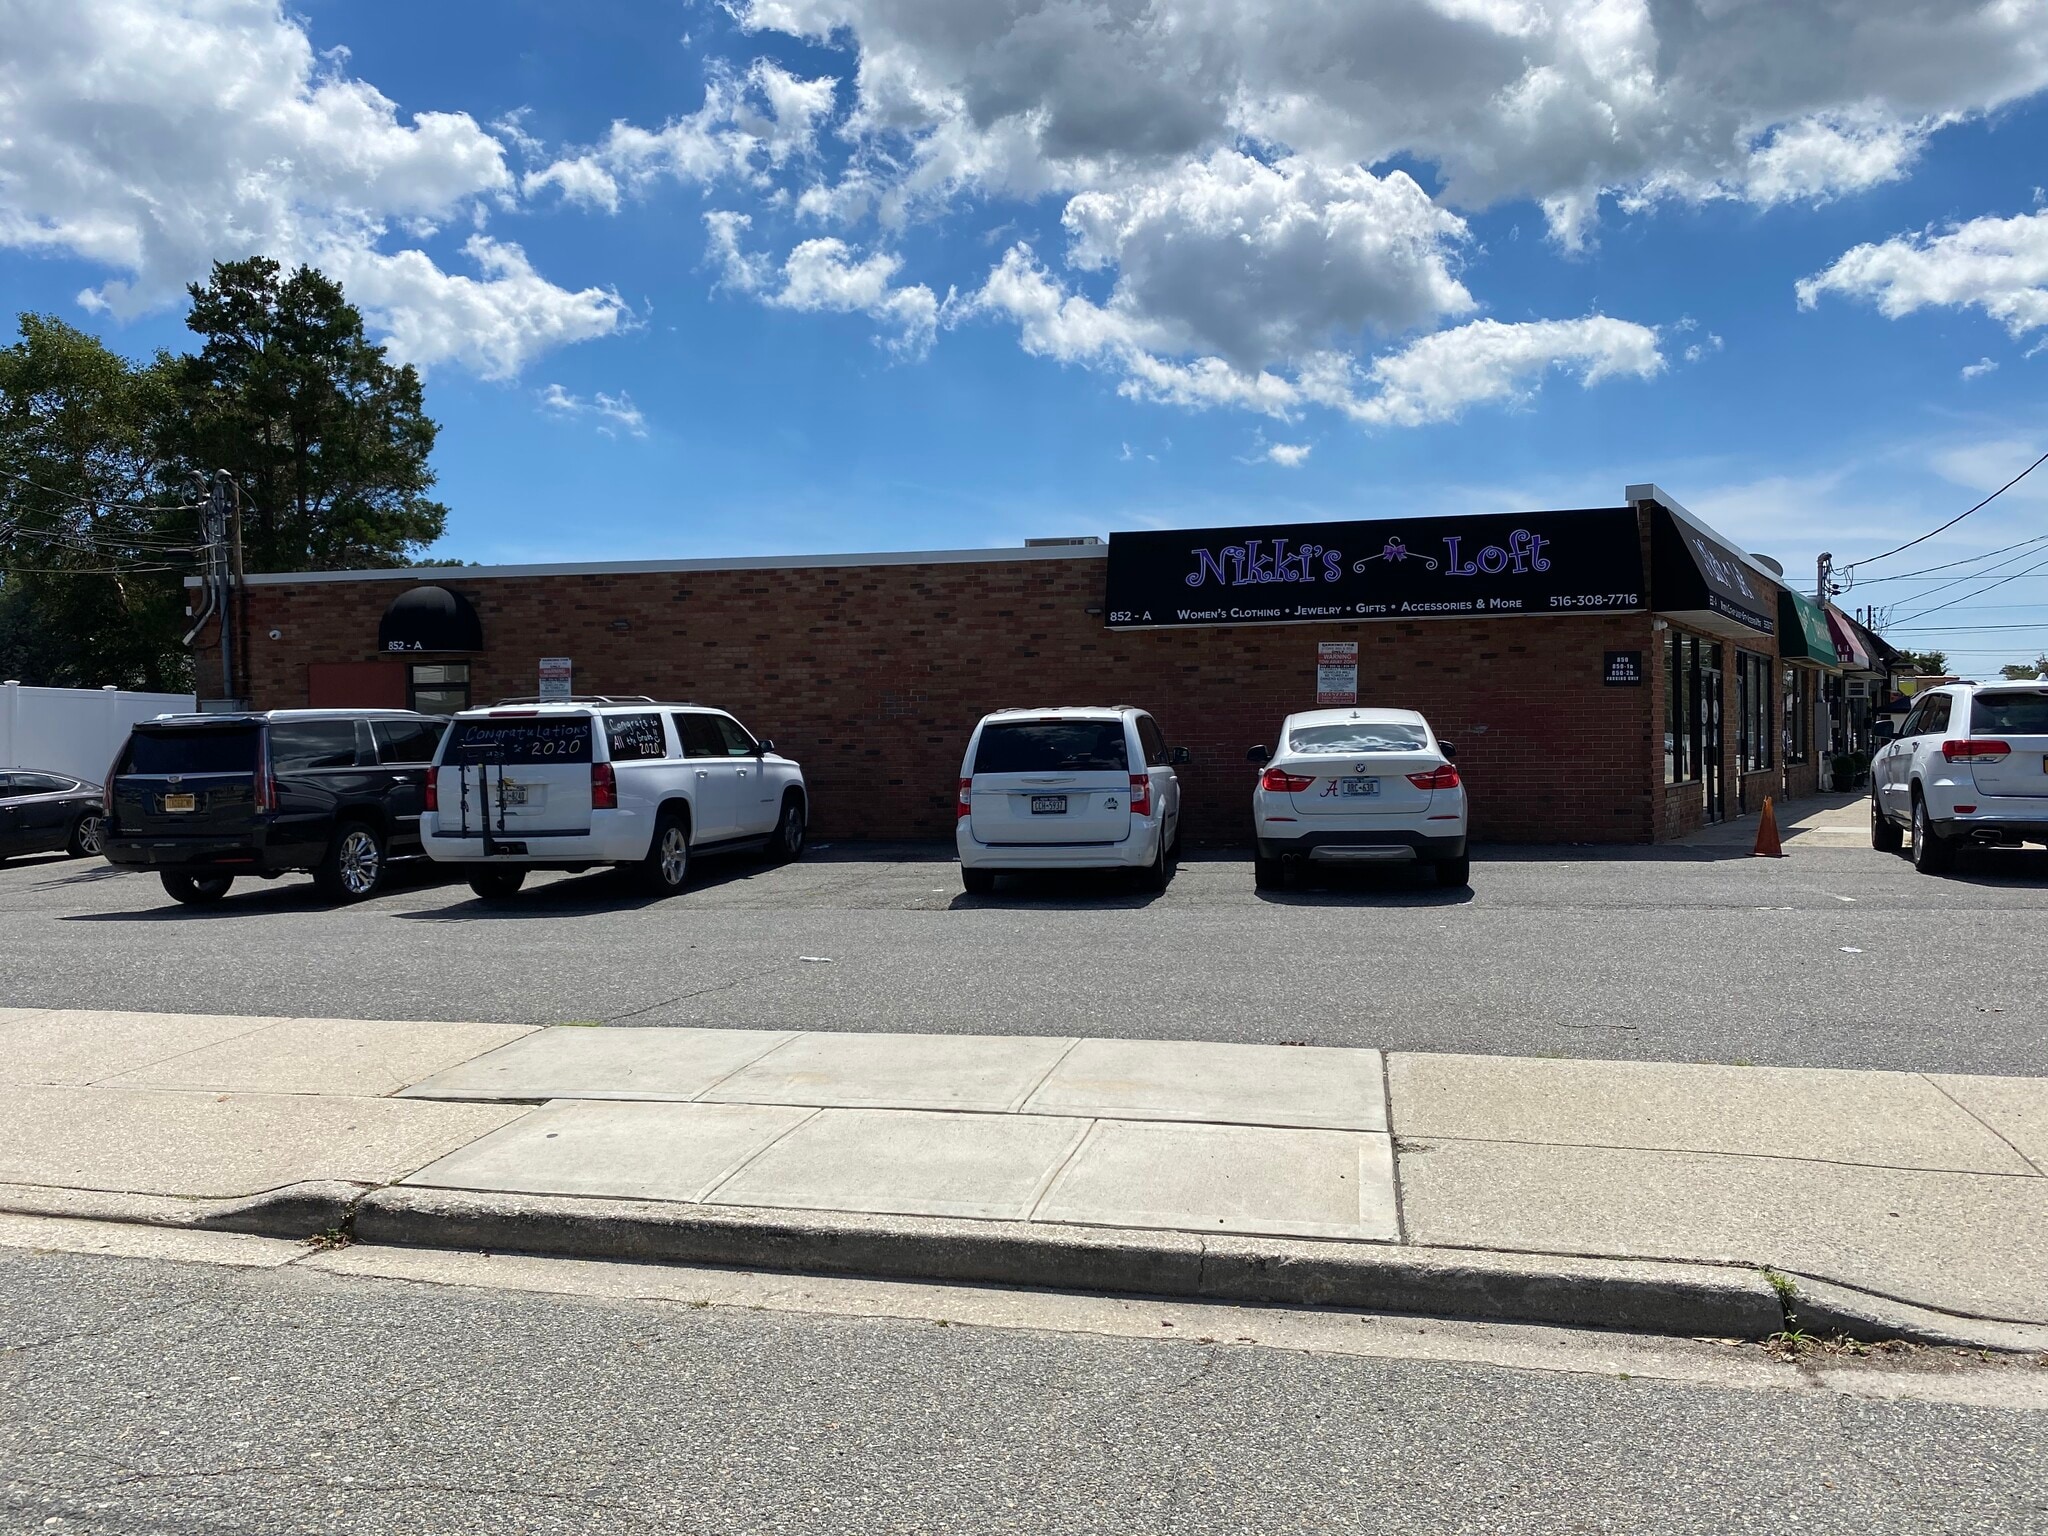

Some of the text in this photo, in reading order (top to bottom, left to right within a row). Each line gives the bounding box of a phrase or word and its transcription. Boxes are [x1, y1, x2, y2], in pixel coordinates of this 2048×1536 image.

[1185, 529, 1551, 587] Nikki's Loft
[1550, 593, 1638, 607] 516-308-7716
[1177, 598, 1522, 619] WOMEN'S CLOTHING JEWELRY GIFTS ACCESSORIES & MORE
[1109, 611, 1131, 622] 852
[388, 641, 404, 650] 852
[531, 740, 580, 755] 2020
[639, 742, 660, 755] 2020
